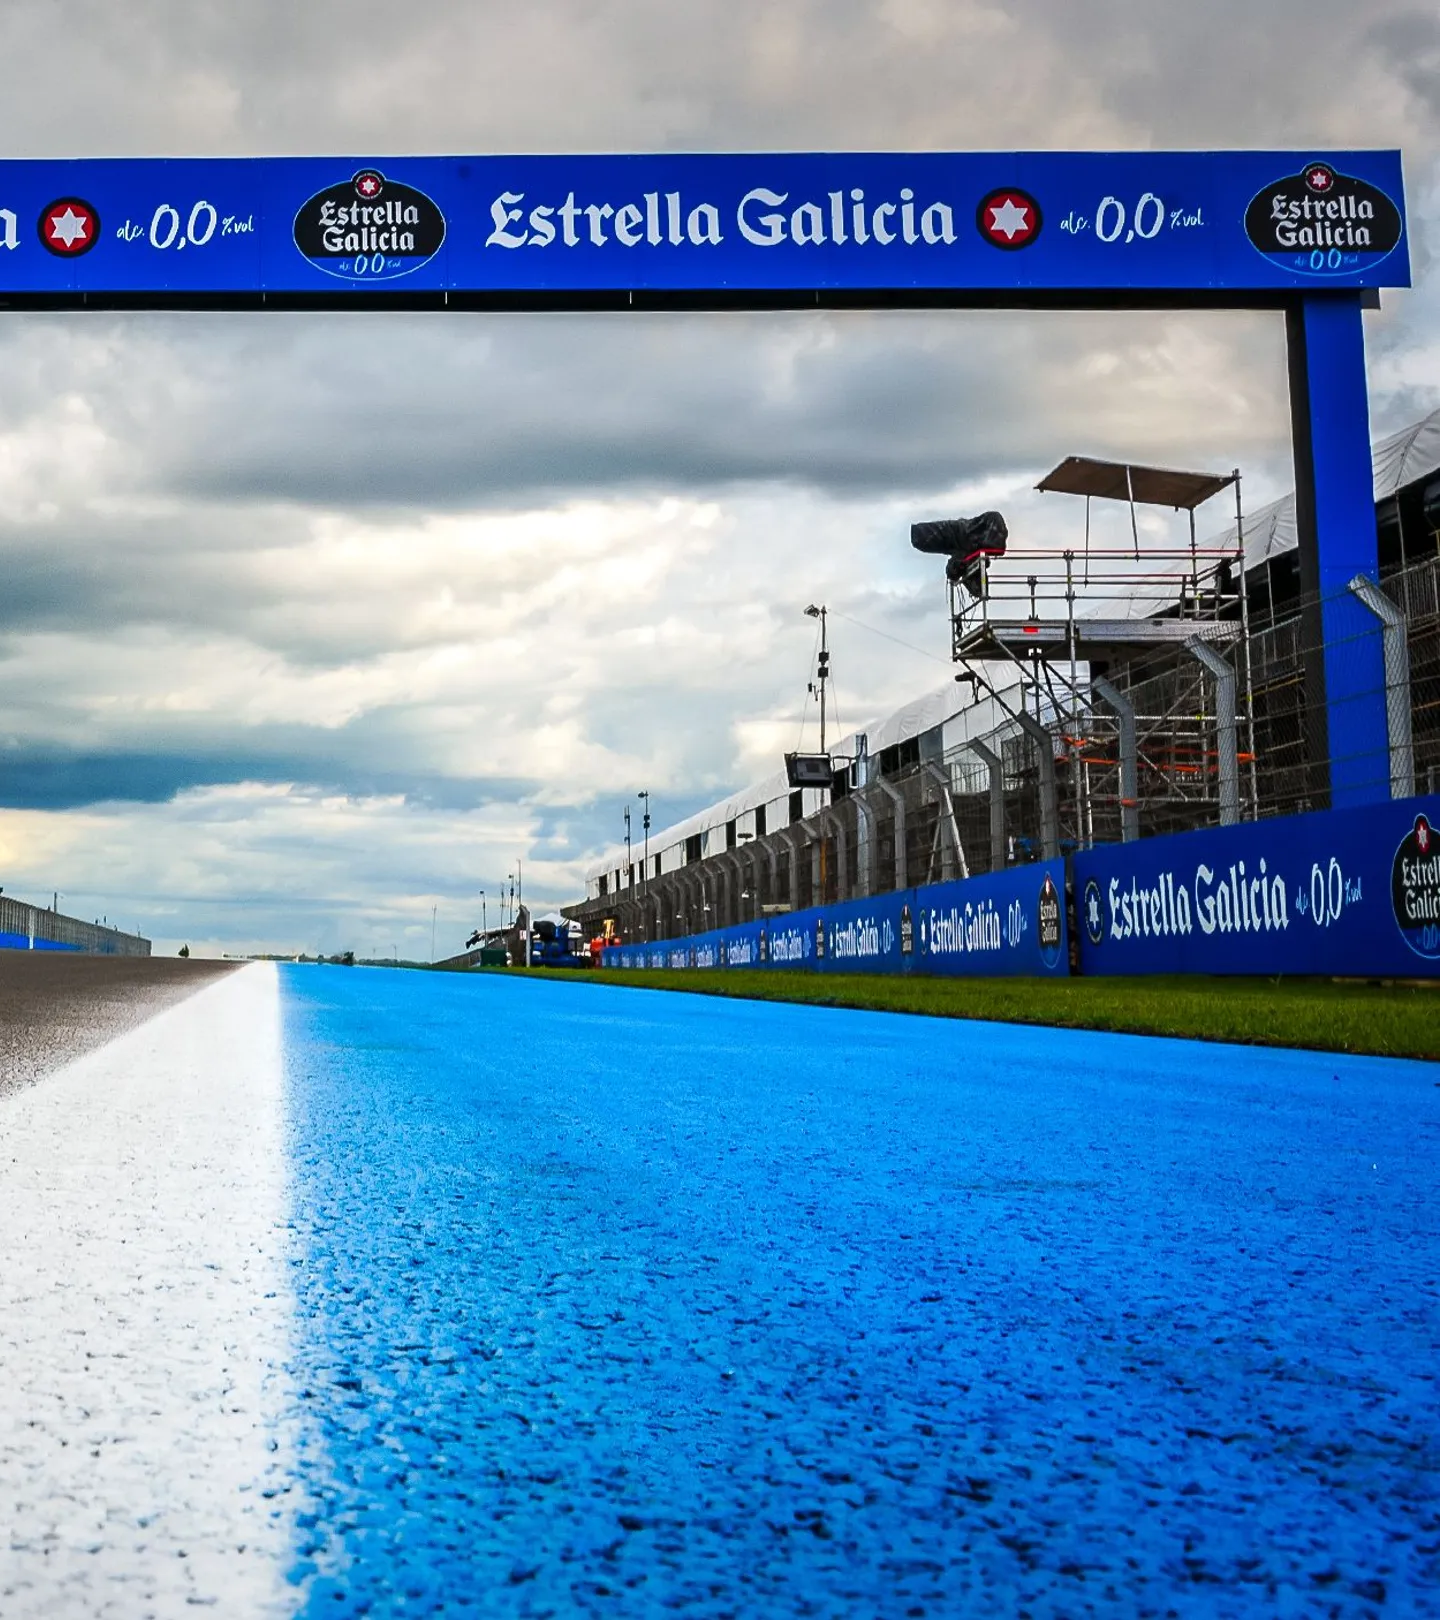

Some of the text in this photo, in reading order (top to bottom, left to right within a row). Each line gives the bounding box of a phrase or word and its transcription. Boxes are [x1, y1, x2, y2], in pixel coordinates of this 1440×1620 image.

[149, 200, 217, 250] 0,0
[319, 200, 419, 226] Estrella
[485, 191, 723, 249] Estrella
[737, 188, 958, 247] Galicia
[1096, 192, 1165, 243] 0,0
[1270, 194, 1374, 220] Estrella
[322, 226, 415, 252] Galicia
[1275, 220, 1371, 247] Galicia
[1109, 872, 1192, 940] Estrella
[1196, 858, 1289, 934] Galicia
[1311, 857, 1342, 927] 0,0
[930, 907, 963, 954] Estrella
[965, 899, 1000, 952] Galicia
